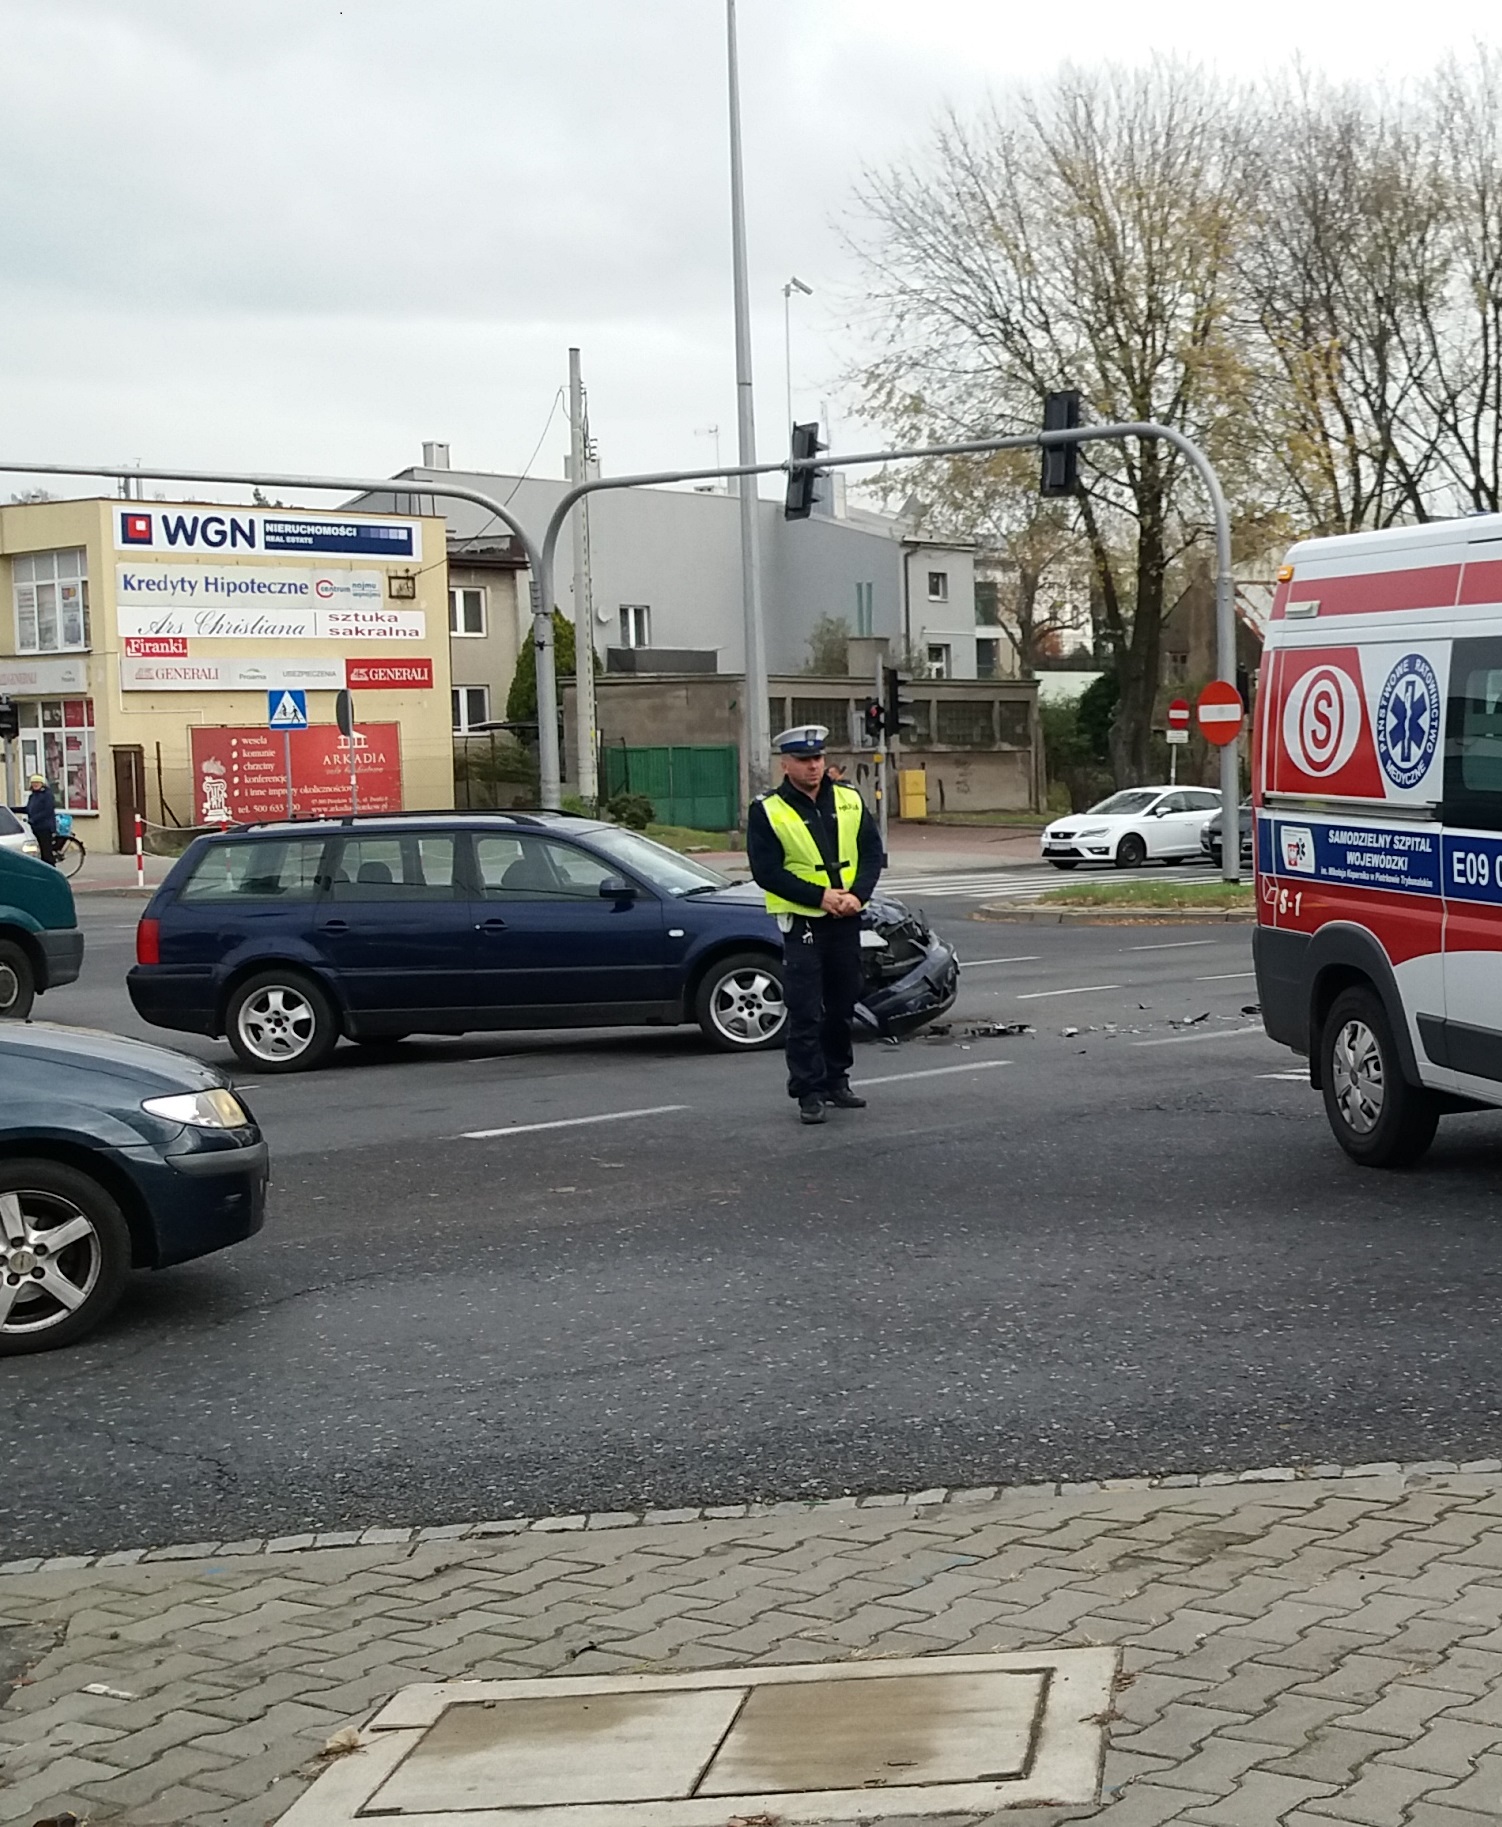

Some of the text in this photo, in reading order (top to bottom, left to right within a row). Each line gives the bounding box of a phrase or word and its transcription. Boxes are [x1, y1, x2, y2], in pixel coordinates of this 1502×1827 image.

[162, 514, 256, 548] WGN
[265, 522, 357, 537] NIERUCHOMOŚCI
[265, 535, 314, 544] REAL ESTATE
[122, 574, 309, 598] Kredyty Hipoteczne
[138, 610, 306, 636] Ars Christiana
[328, 612, 399, 623] sztuka
[328, 626, 420, 637] sakralna
[156, 668, 219, 680] GENERALI
[368, 668, 428, 681] GENERALI
[1311, 690, 1333, 742] S
[1415, 659, 1439, 754] RATOWNICTWO
[322, 752, 386, 766] ARKADIA
[1386, 760, 1427, 785] MEDYCZNE
[1328, 829, 1432, 852] SAMODZIELNY SZPITAL
[1346, 851, 1408, 871] WOJEWÓDZKI
[1453, 850, 1490, 886] E09
[1279, 888, 1302, 916] S-1
